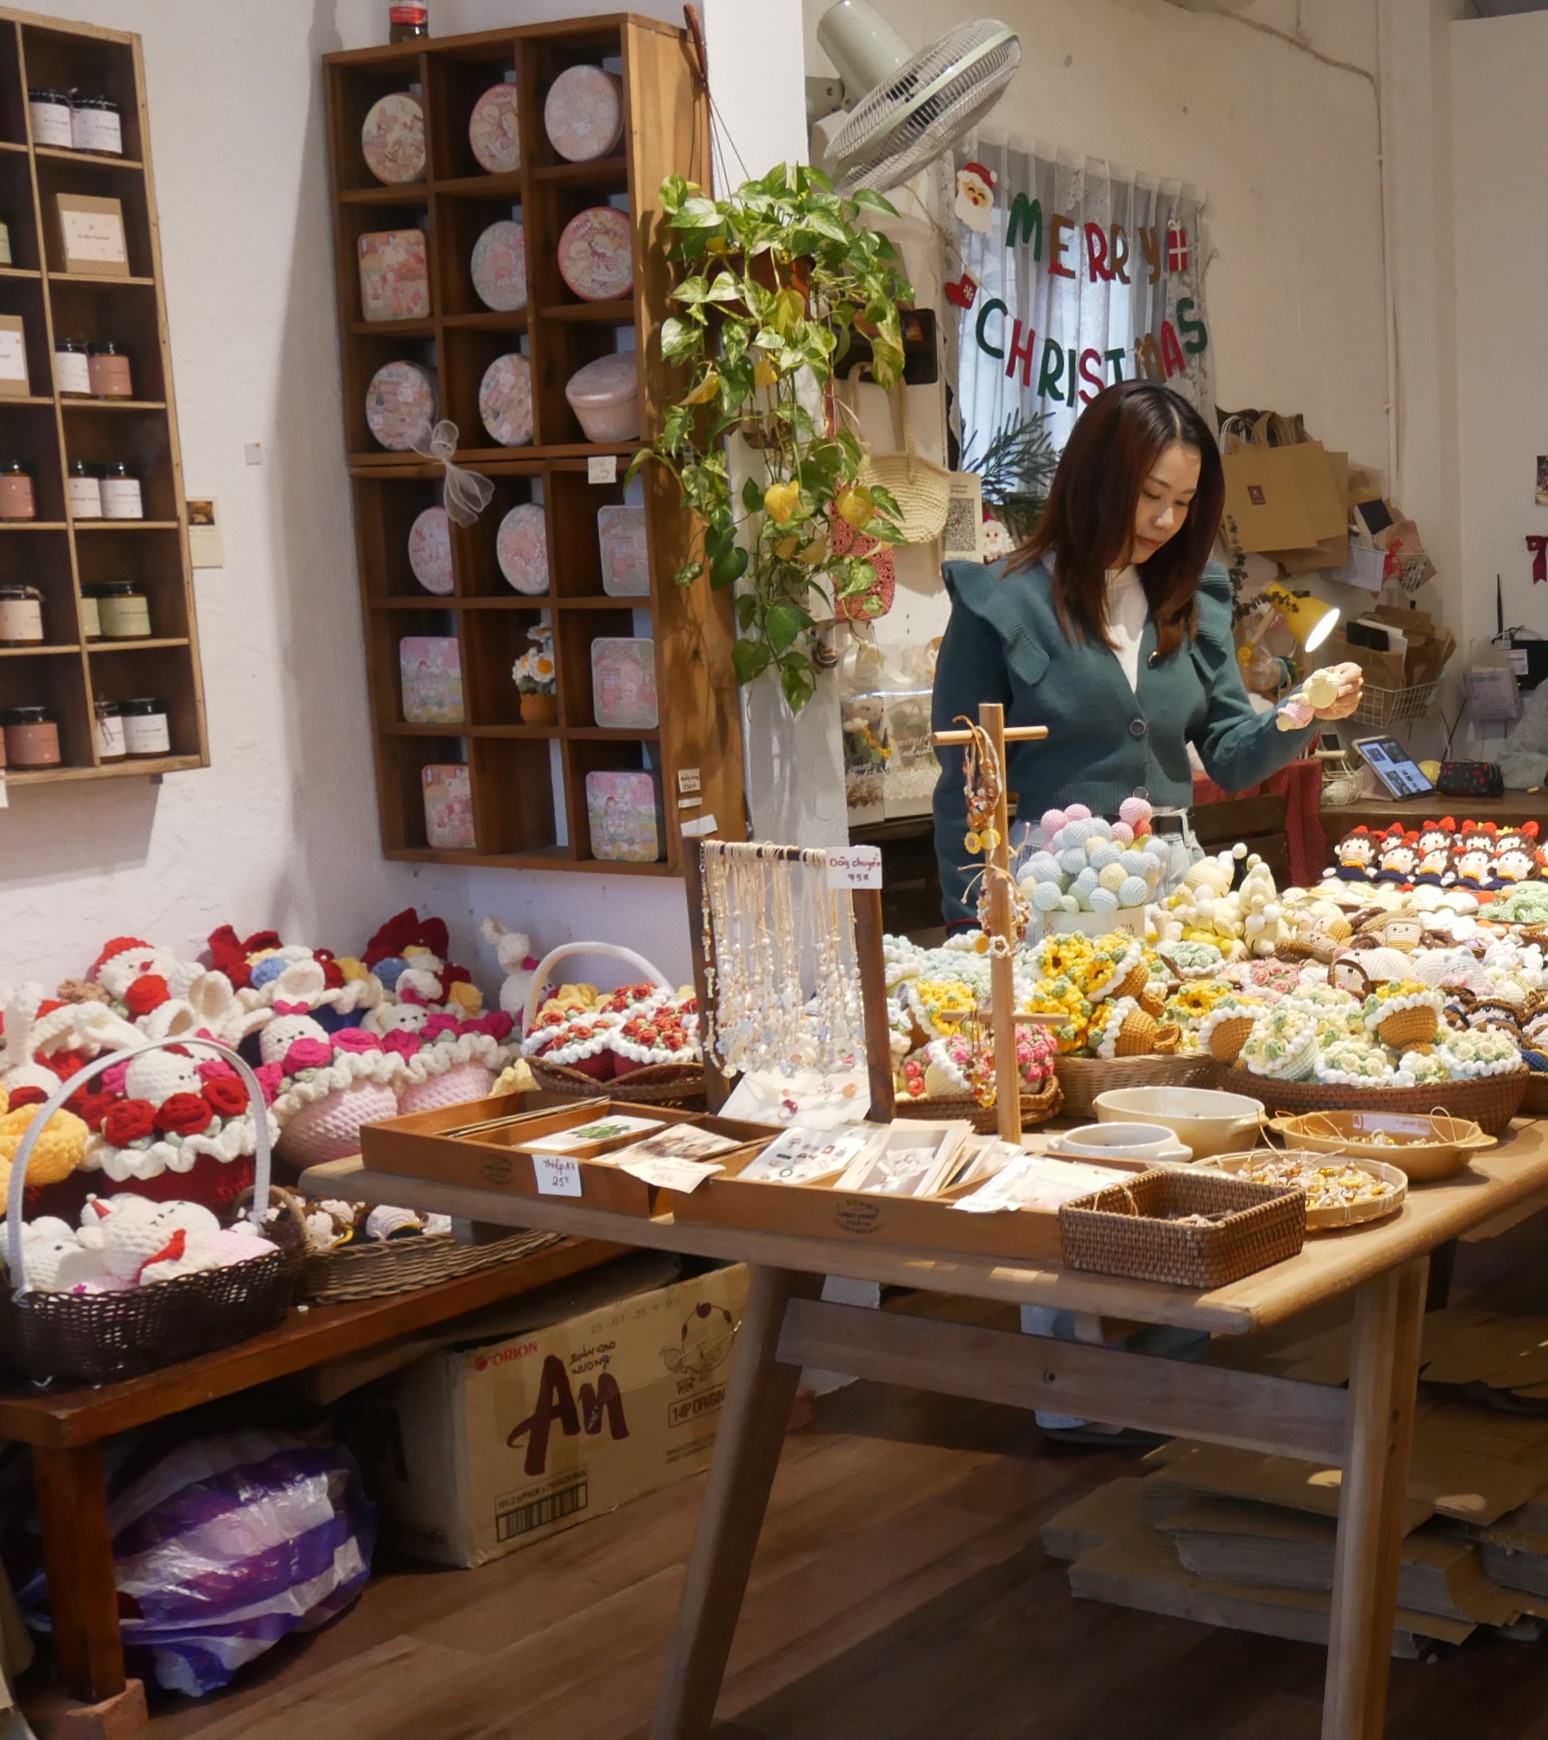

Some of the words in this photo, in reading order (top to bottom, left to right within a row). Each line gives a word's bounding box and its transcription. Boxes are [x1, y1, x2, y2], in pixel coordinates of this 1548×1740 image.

[1006, 192, 1161, 285] MERRY
[975, 297, 1208, 408] CHRISTMAS
[492, 1342, 538, 1365] ORION
[507, 1354, 630, 1476] An
[673, 1403, 691, 1421] 14P
[693, 1387, 726, 1413] ORIGIN
